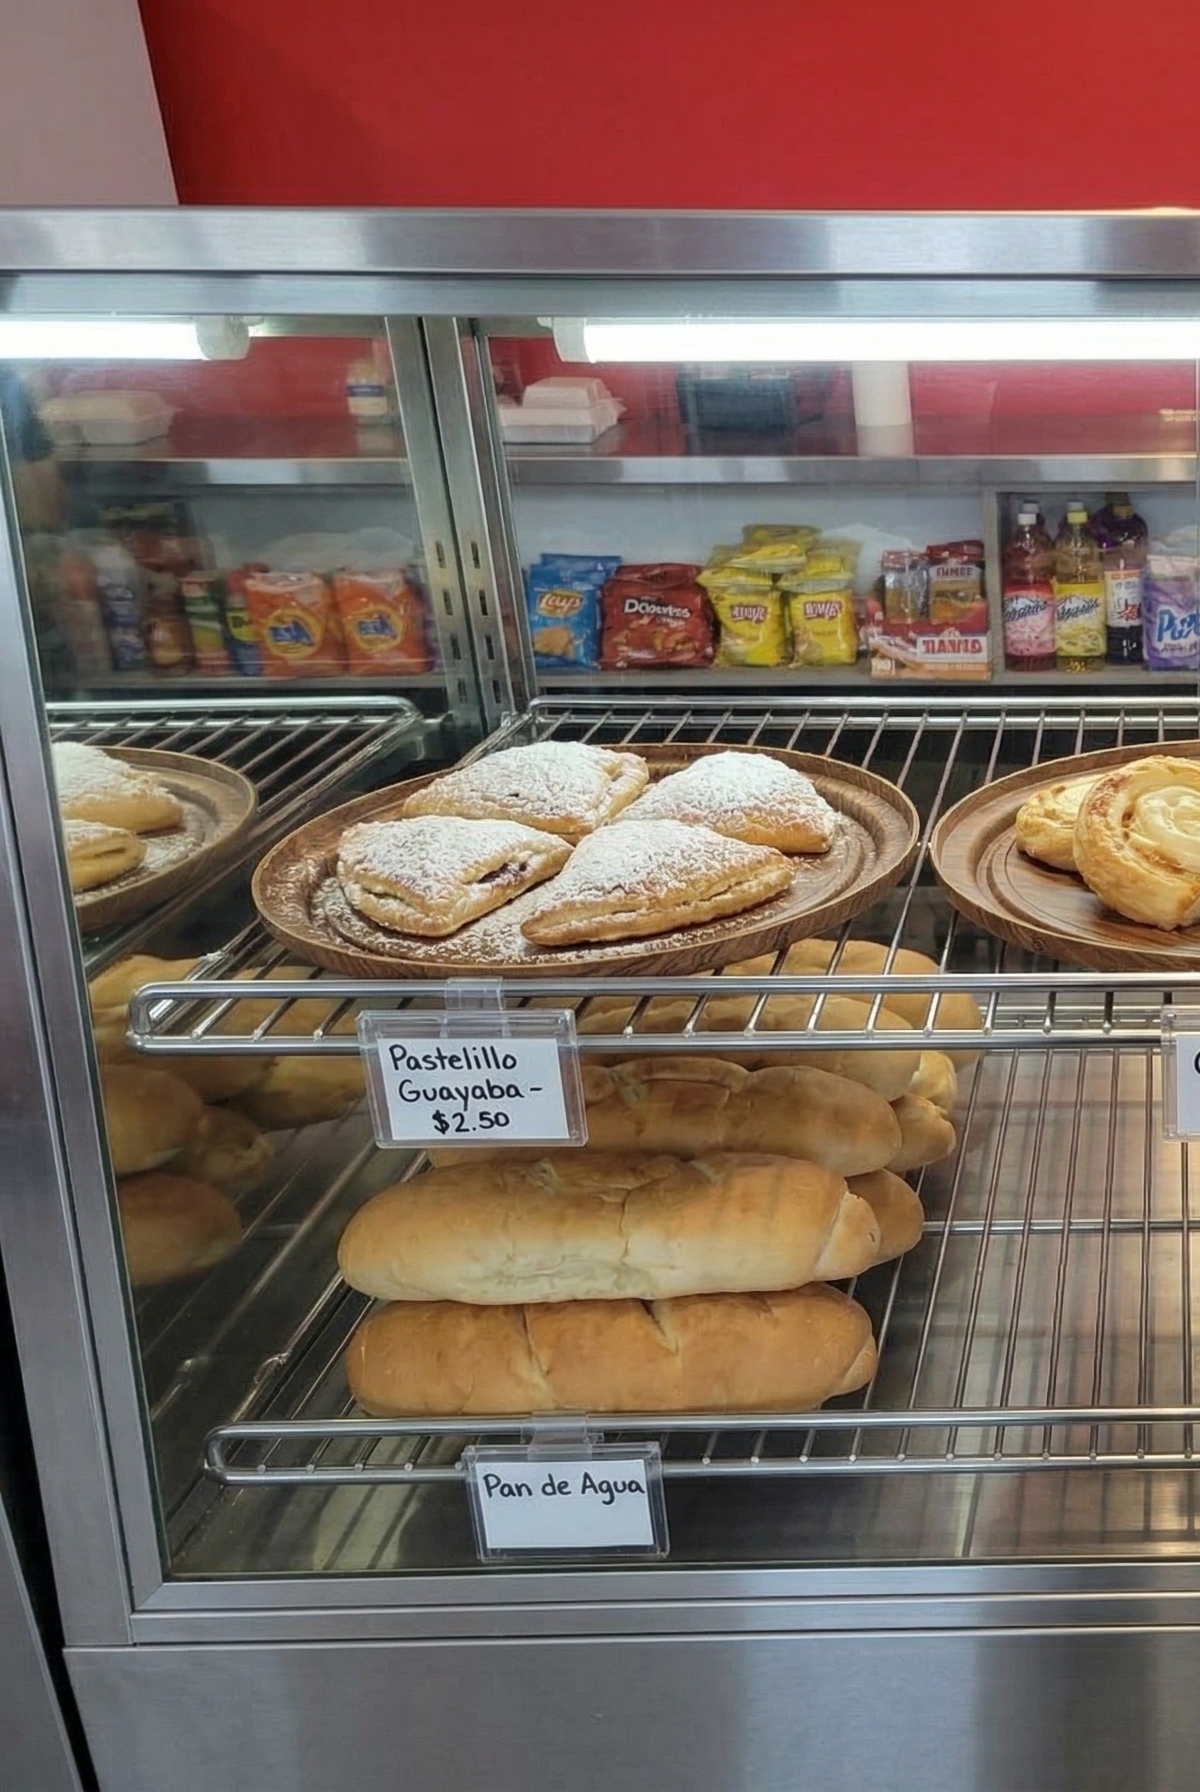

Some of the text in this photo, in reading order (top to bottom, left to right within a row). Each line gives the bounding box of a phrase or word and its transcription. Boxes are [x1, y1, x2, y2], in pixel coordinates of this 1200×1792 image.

[388, 1044, 517, 1071] Pastelillo
[431, 1109, 510, 1135] $2.50
[482, 1471, 645, 1506] Pan de Agua
